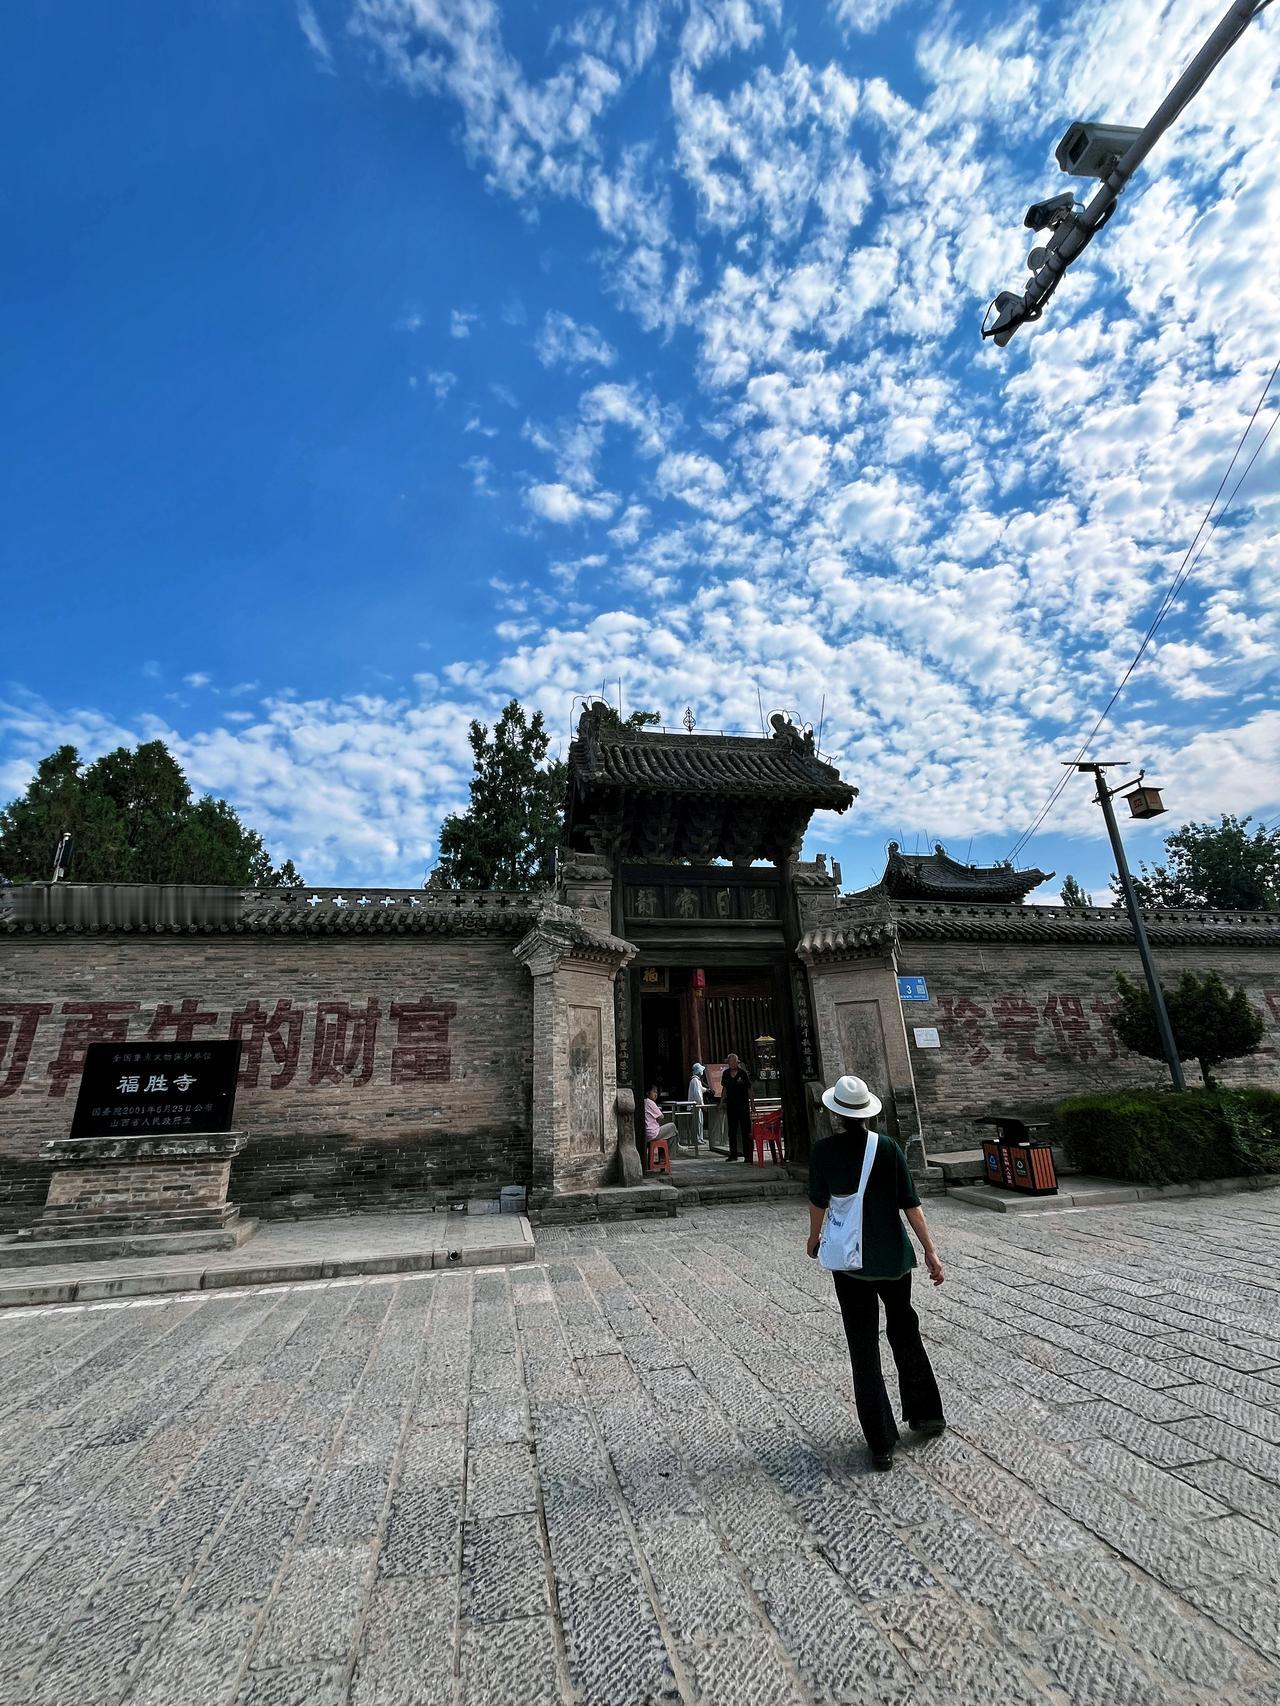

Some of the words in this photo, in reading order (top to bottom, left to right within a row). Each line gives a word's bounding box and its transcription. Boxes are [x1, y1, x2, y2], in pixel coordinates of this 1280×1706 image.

[906, 985, 912, 994] 3
[116, 1073, 198, 1093] 福胜寺
